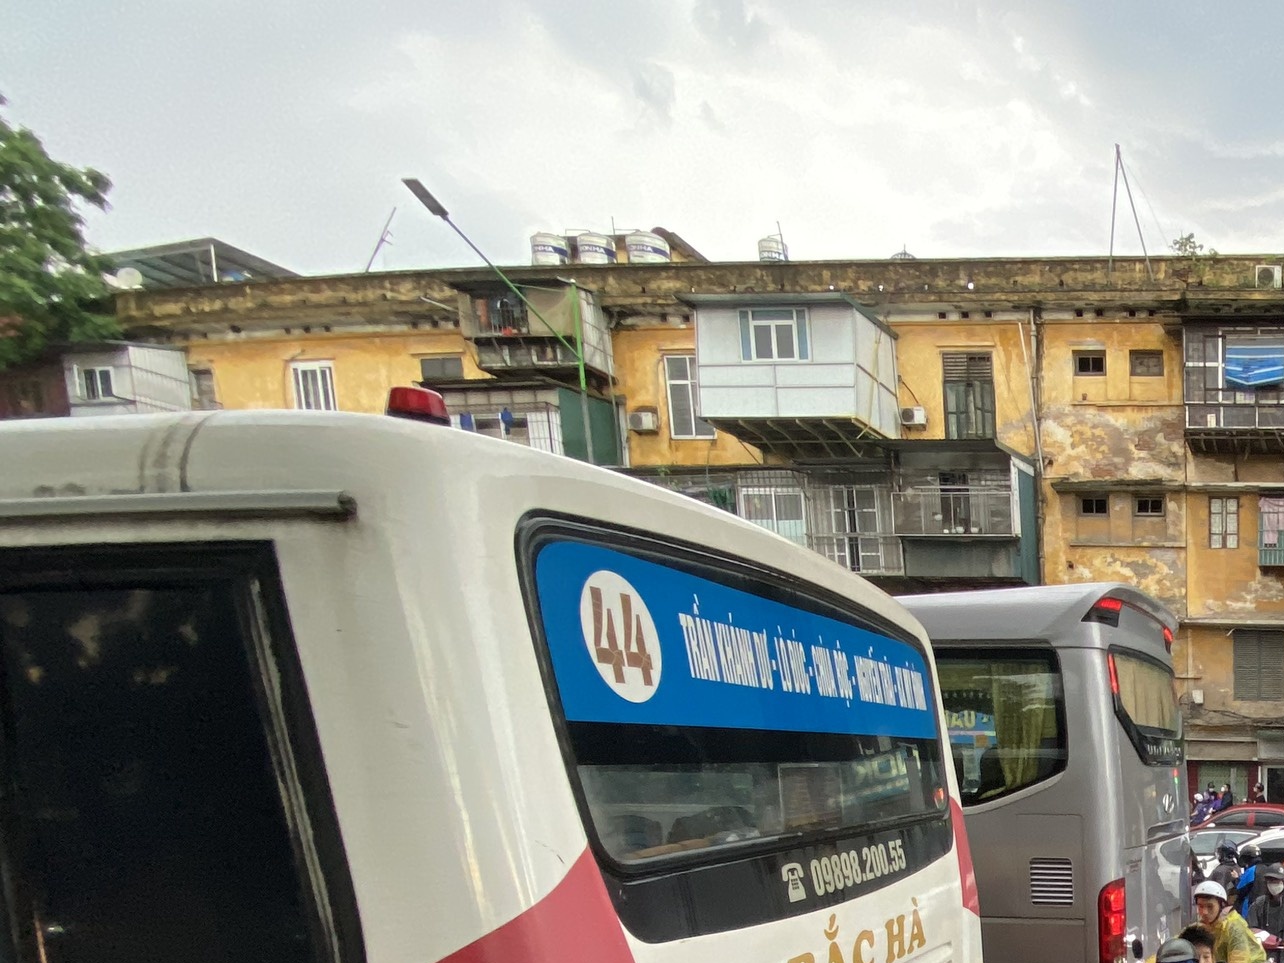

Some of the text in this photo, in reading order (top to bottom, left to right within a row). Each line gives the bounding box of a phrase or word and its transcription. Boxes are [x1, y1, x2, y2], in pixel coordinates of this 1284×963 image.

[590, 586, 653, 686] 44
[714, 612, 759, 688] KHÁNH
[810, 839, 907, 896] 09898.200.55
